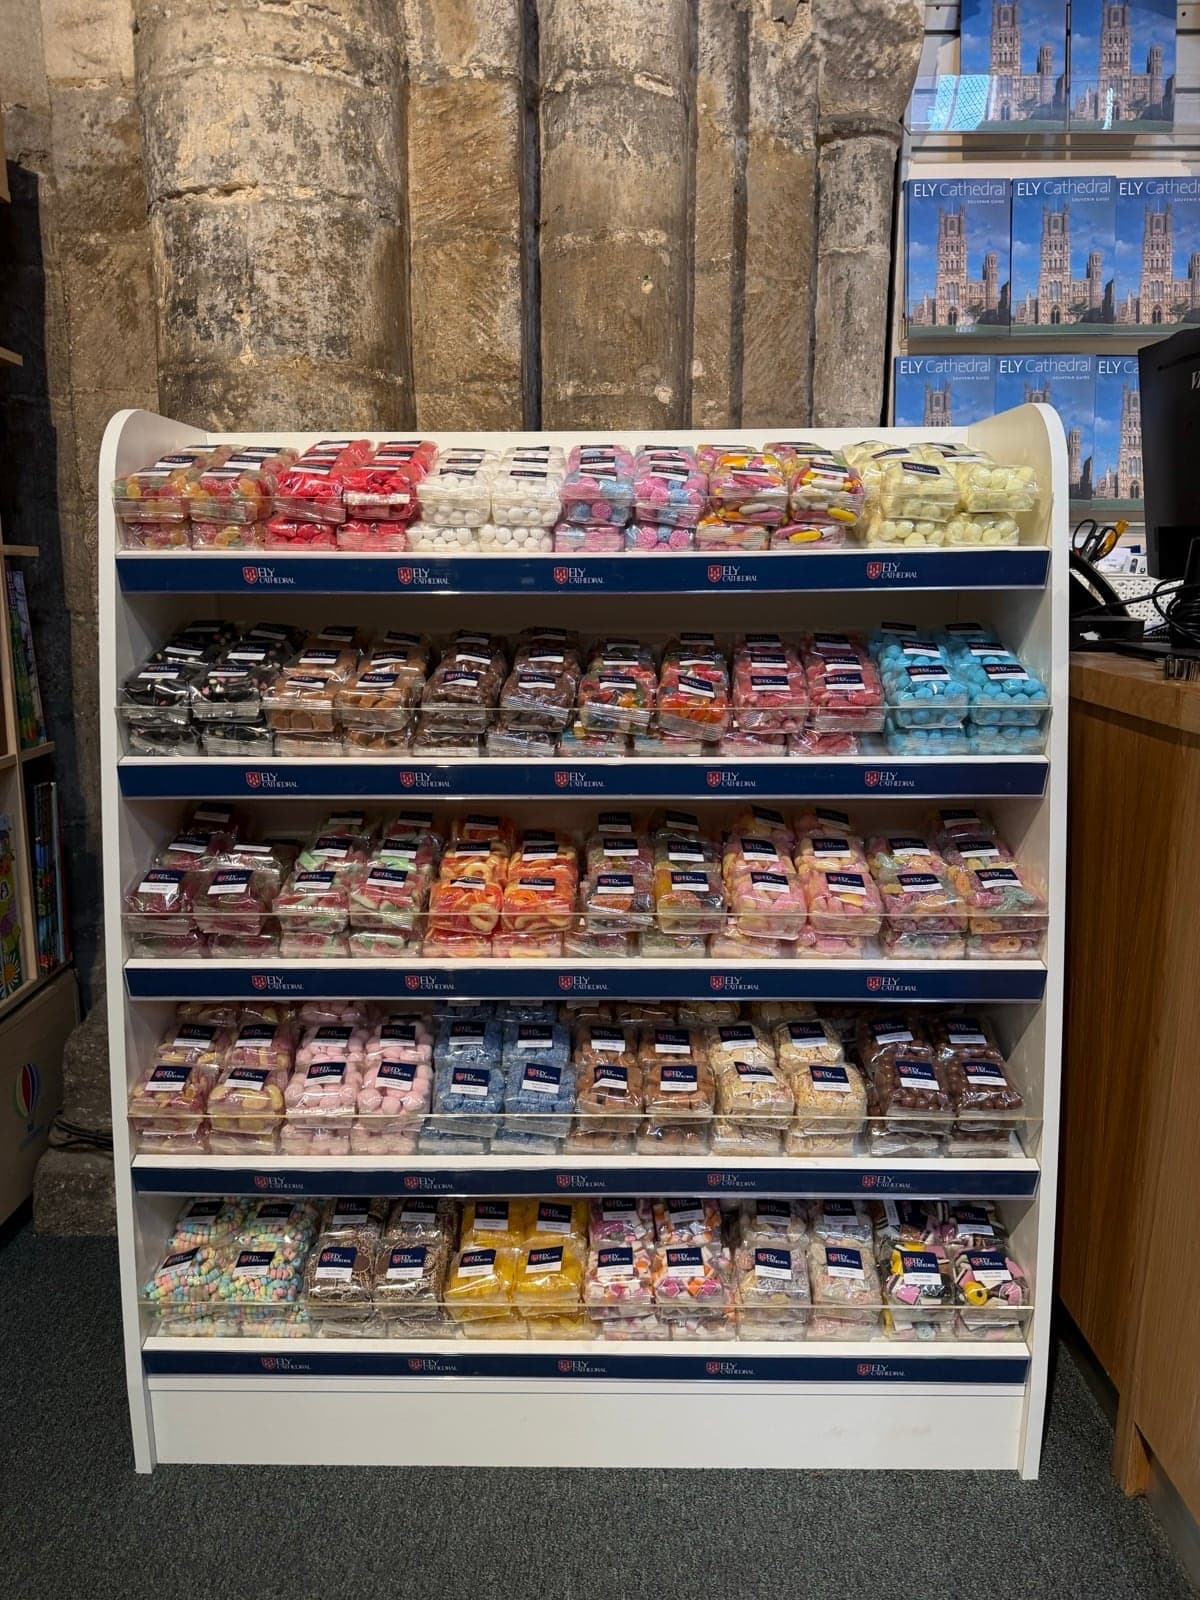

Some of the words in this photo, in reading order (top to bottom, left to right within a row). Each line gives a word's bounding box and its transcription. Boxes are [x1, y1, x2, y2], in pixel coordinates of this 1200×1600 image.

[914, 184, 937, 197] ELY
[940, 181, 1006, 196] Cathedral
[1017, 182, 1041, 196] ELY
[1043, 178, 1111, 195] Cathedral
[1120, 182, 1143, 195] ELY
[900, 360, 923, 374] ELY
[925, 358, 991, 373] Cathedral
[1000, 360, 1023, 373] ELY
[1025, 357, 1091, 372] Cathedral
[1099, 361, 1121, 374] ELY
[723, 566, 740, 575] ELY
[882, 562, 900, 571] ELY
[258, 568, 275, 577] ELY
[413, 568, 429, 577] ELY
[569, 568, 586, 577] ELY
[261, 772, 278, 781] ELY
[415, 772, 432, 781] ELY
[570, 772, 586, 781] ELY
[722, 772, 739, 780] ELY
[880, 772, 898, 780] ELY
[267, 976, 283, 984] ELY
[420, 976, 436, 984] ELY
[573, 976, 590, 984] ELY
[725, 976, 742, 984] ELY
